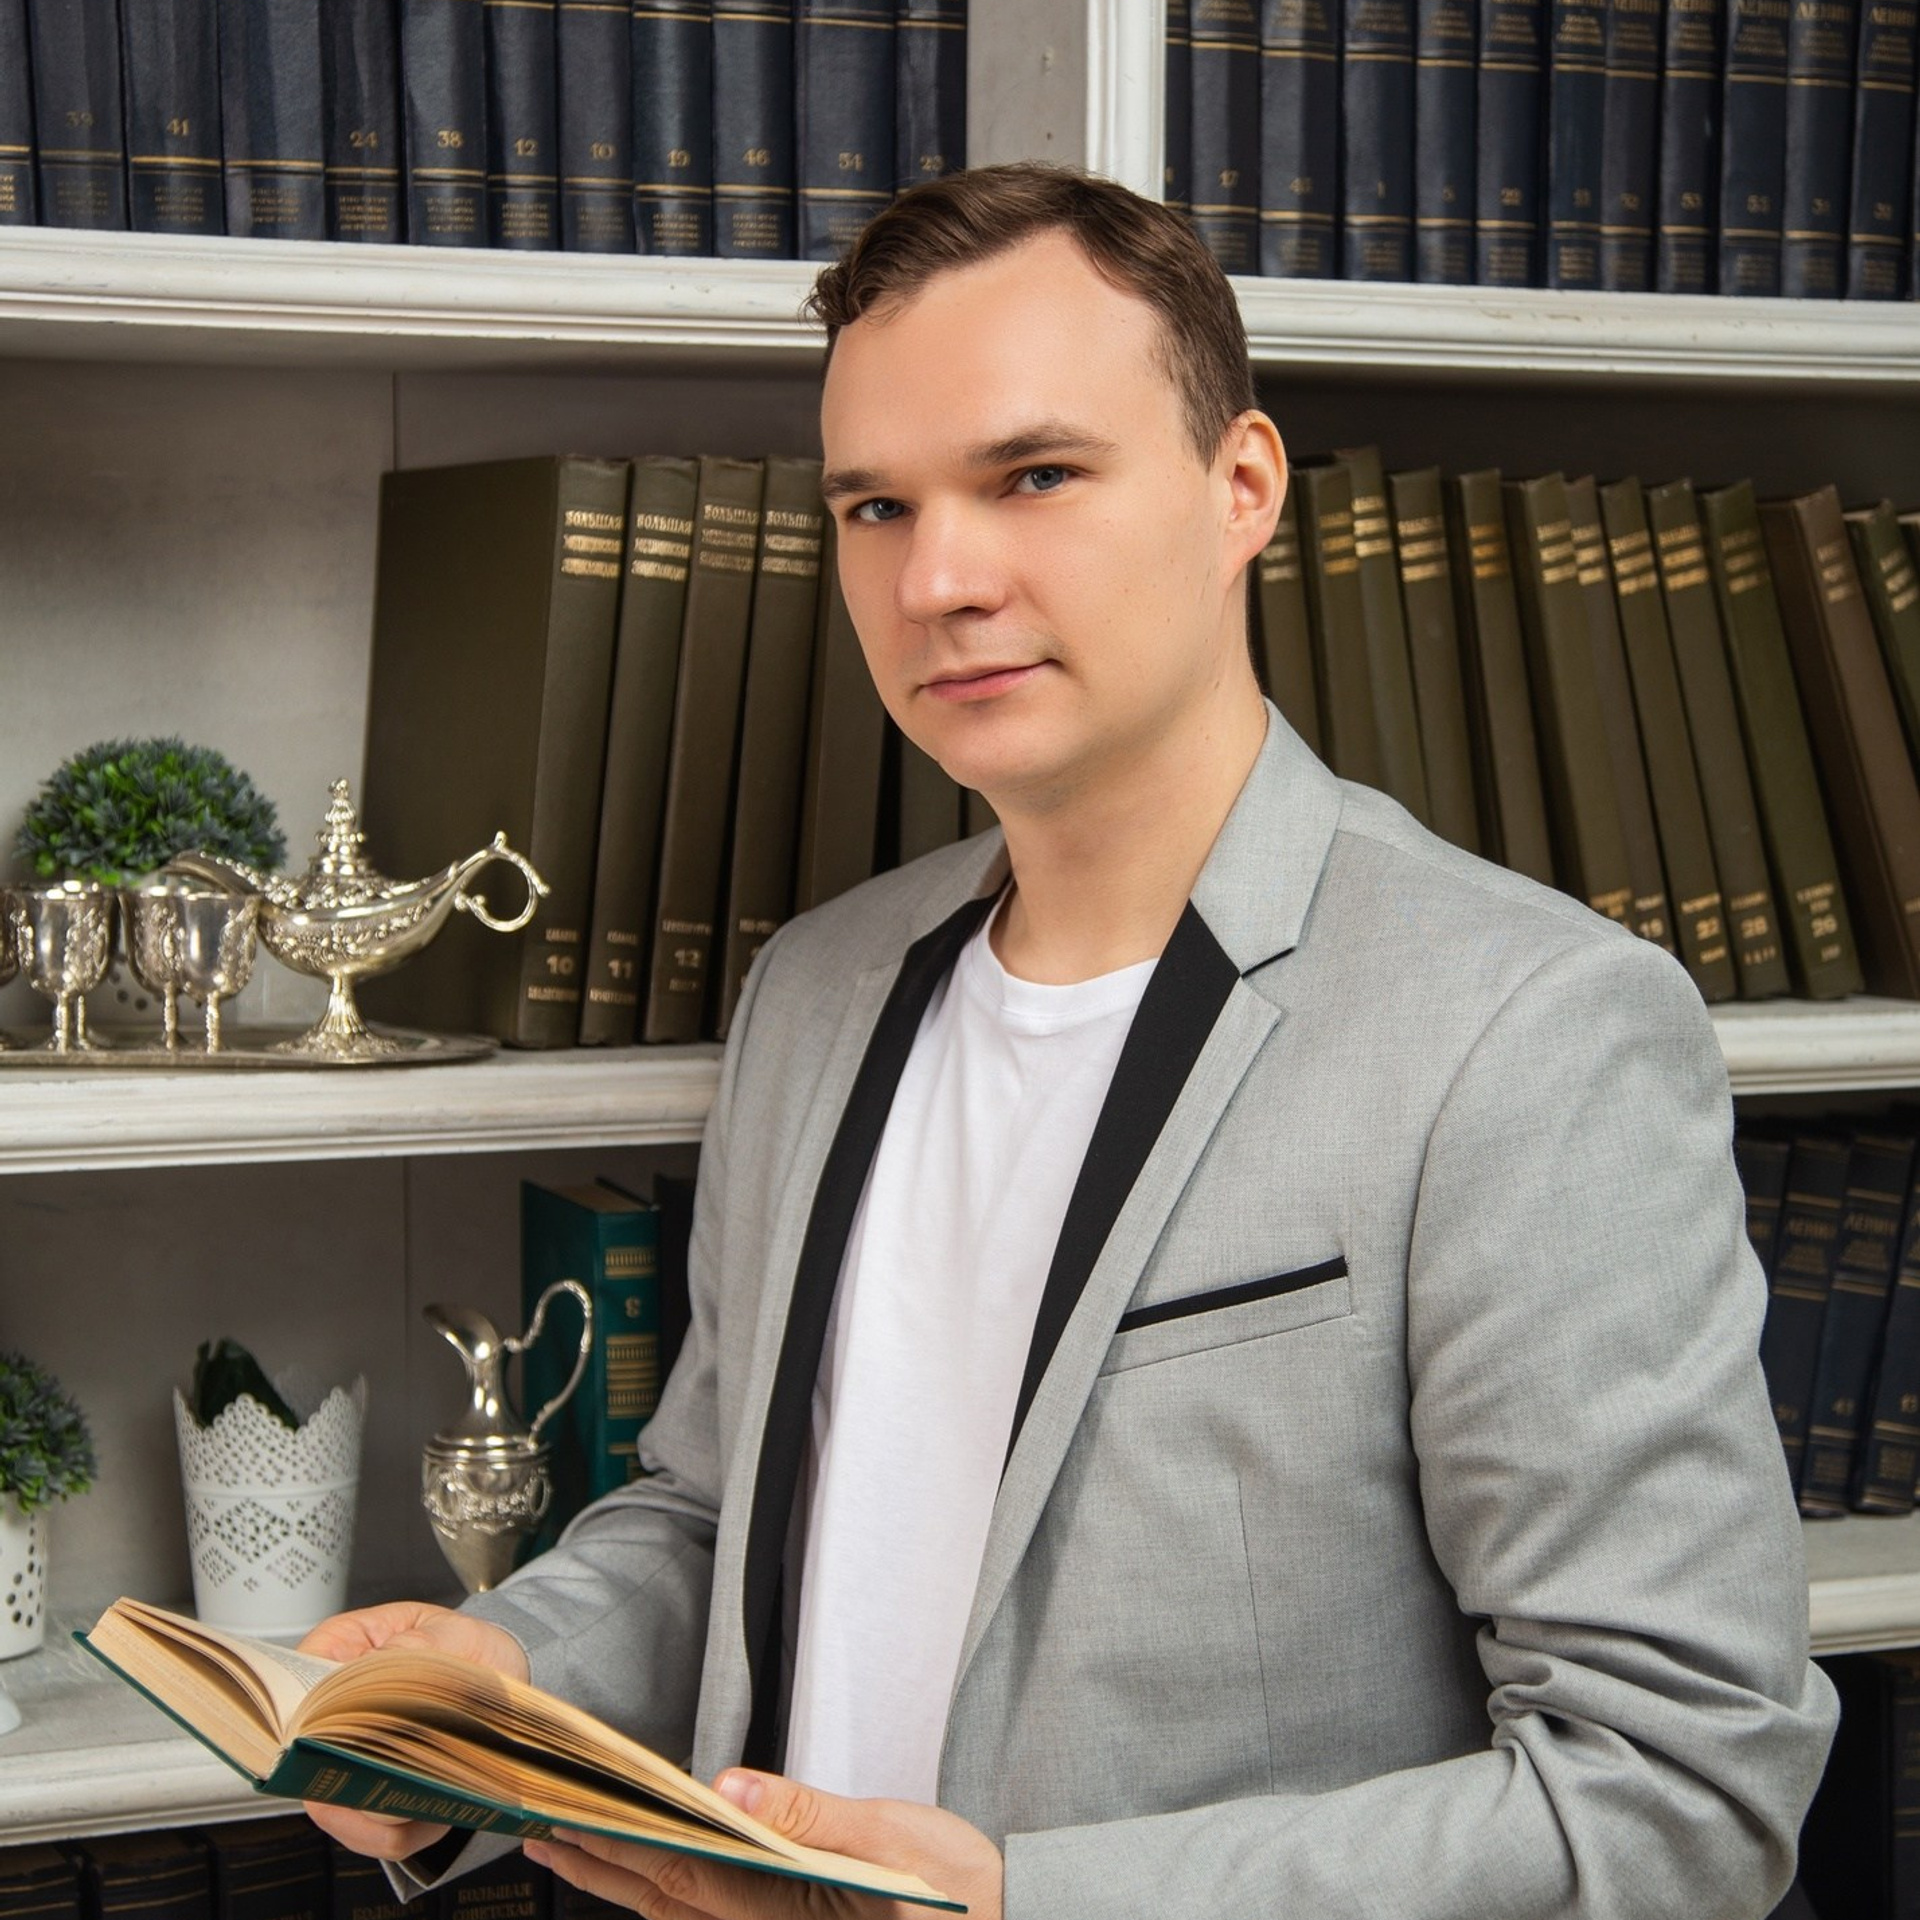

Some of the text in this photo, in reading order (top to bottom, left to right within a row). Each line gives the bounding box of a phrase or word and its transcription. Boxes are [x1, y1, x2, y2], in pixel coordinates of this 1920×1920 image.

[167, 118, 190, 136] 41
[350, 131, 379, 149] 24
[437, 130, 464, 149] 38
[514, 138, 540, 157] 12
[590, 142, 614, 161] 10
[565, 510, 624, 531] БОЛЬШАЯ
[636, 513, 694, 536] БОЛЬШАЯ
[704, 504, 760, 525] БОЛЬШАЯ
[546, 954, 575, 975] 10
[607, 959, 633, 979] 11
[674, 949, 700, 969] 12
